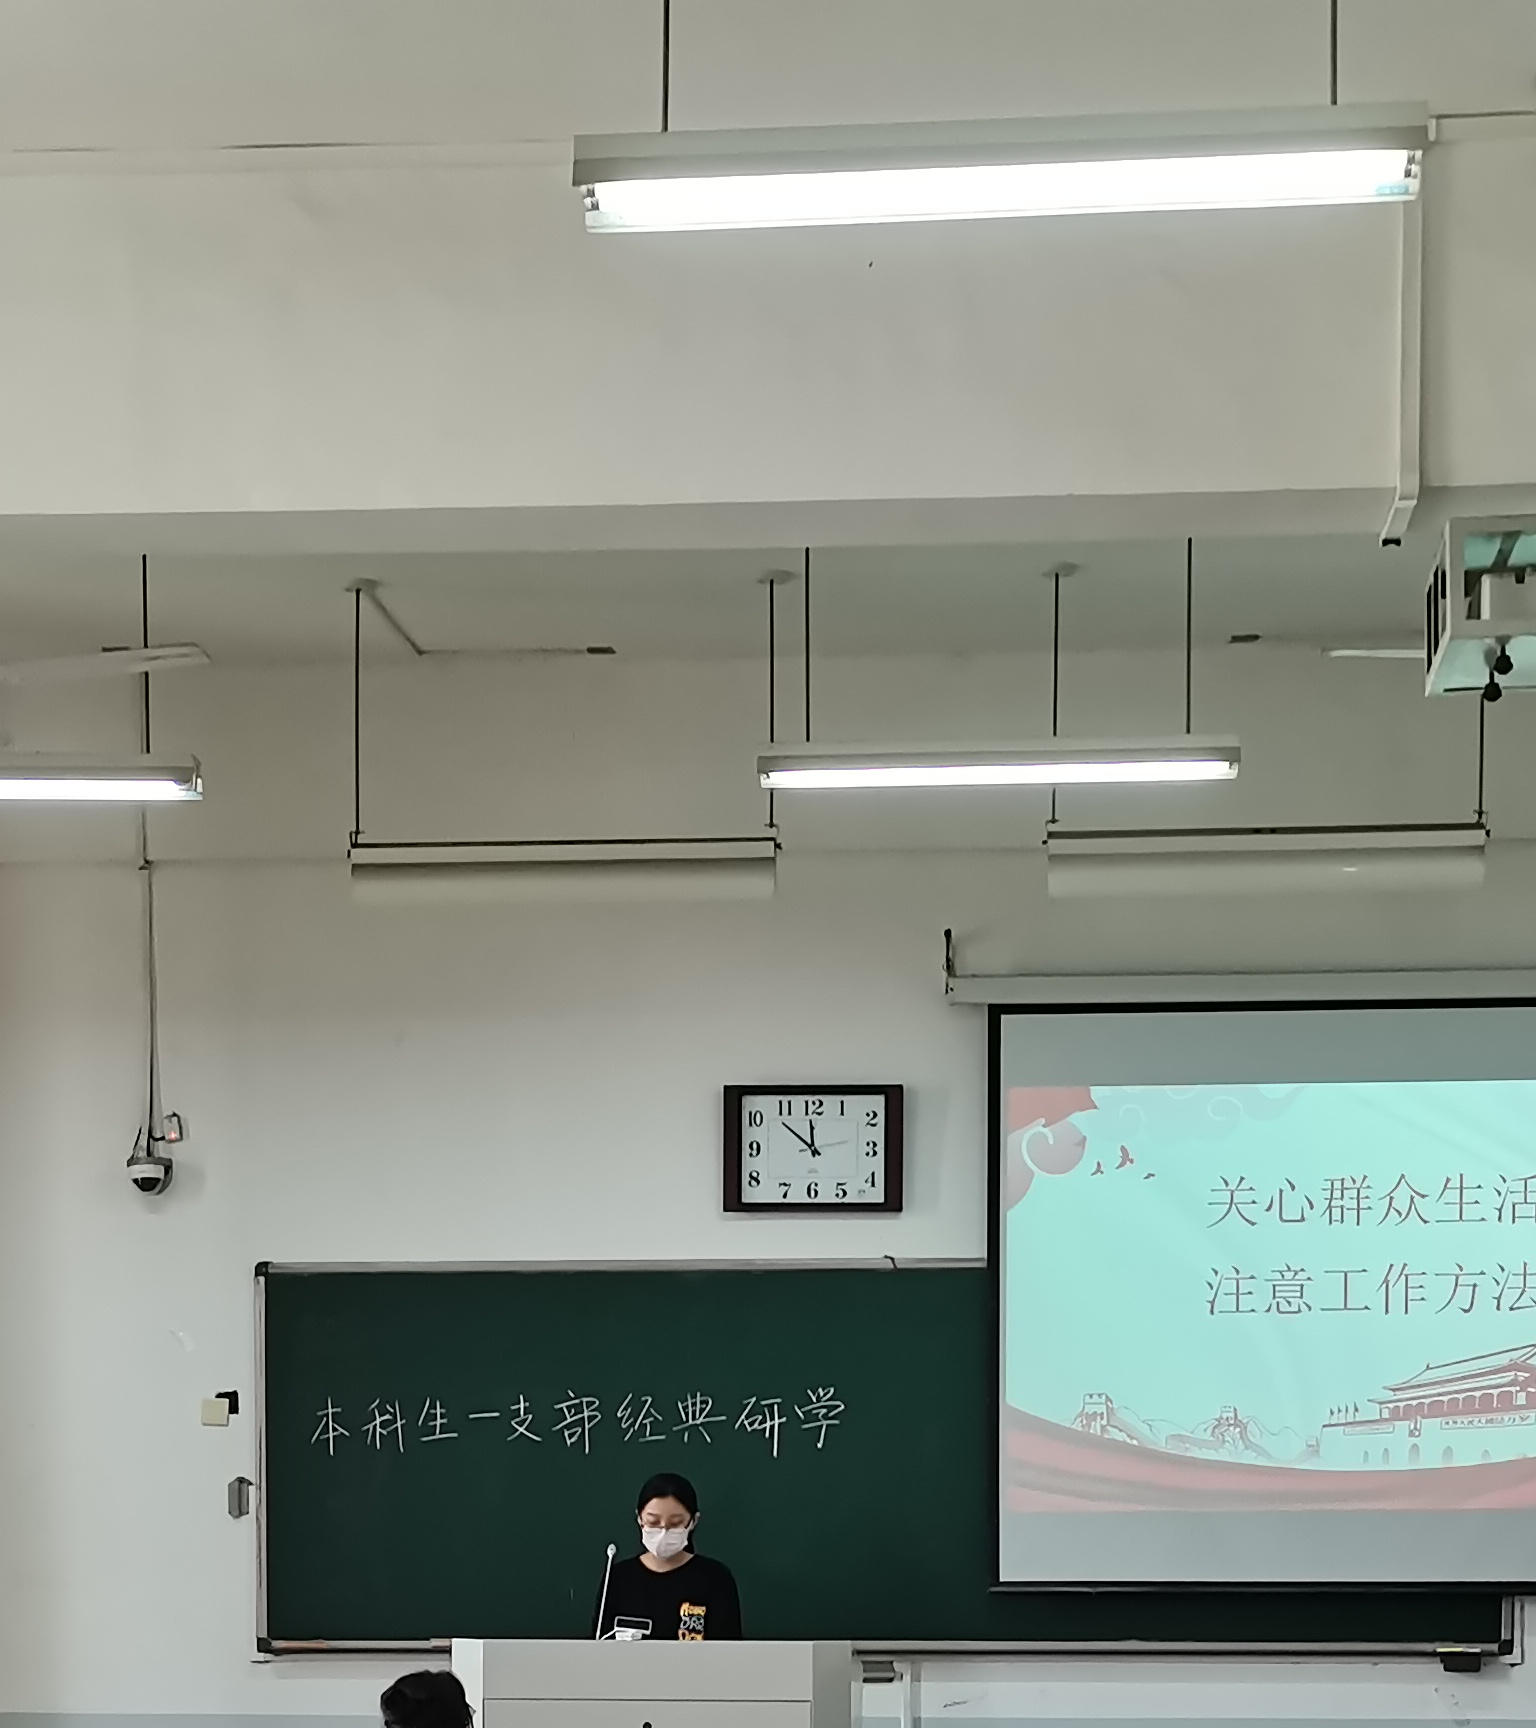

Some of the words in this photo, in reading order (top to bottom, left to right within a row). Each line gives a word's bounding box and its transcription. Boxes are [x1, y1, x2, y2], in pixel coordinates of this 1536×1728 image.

[778, 1099, 792, 1117] 11
[804, 1098, 825, 1117] 12
[838, 1099, 846, 1117] 1
[748, 1109, 764, 1128] 10
[864, 1109, 879, 1128] 2
[748, 1139, 762, 1158] 9
[865, 1140, 878, 1158] 3
[747, 1169, 761, 1188] 8
[864, 1170, 877, 1188] 4
[778, 1181, 792, 1200] 7
[806, 1181, 819, 1200] 6
[834, 1181, 848, 1200] 5
[310, 1386, 845, 1458] 本科生一支部经典研学
